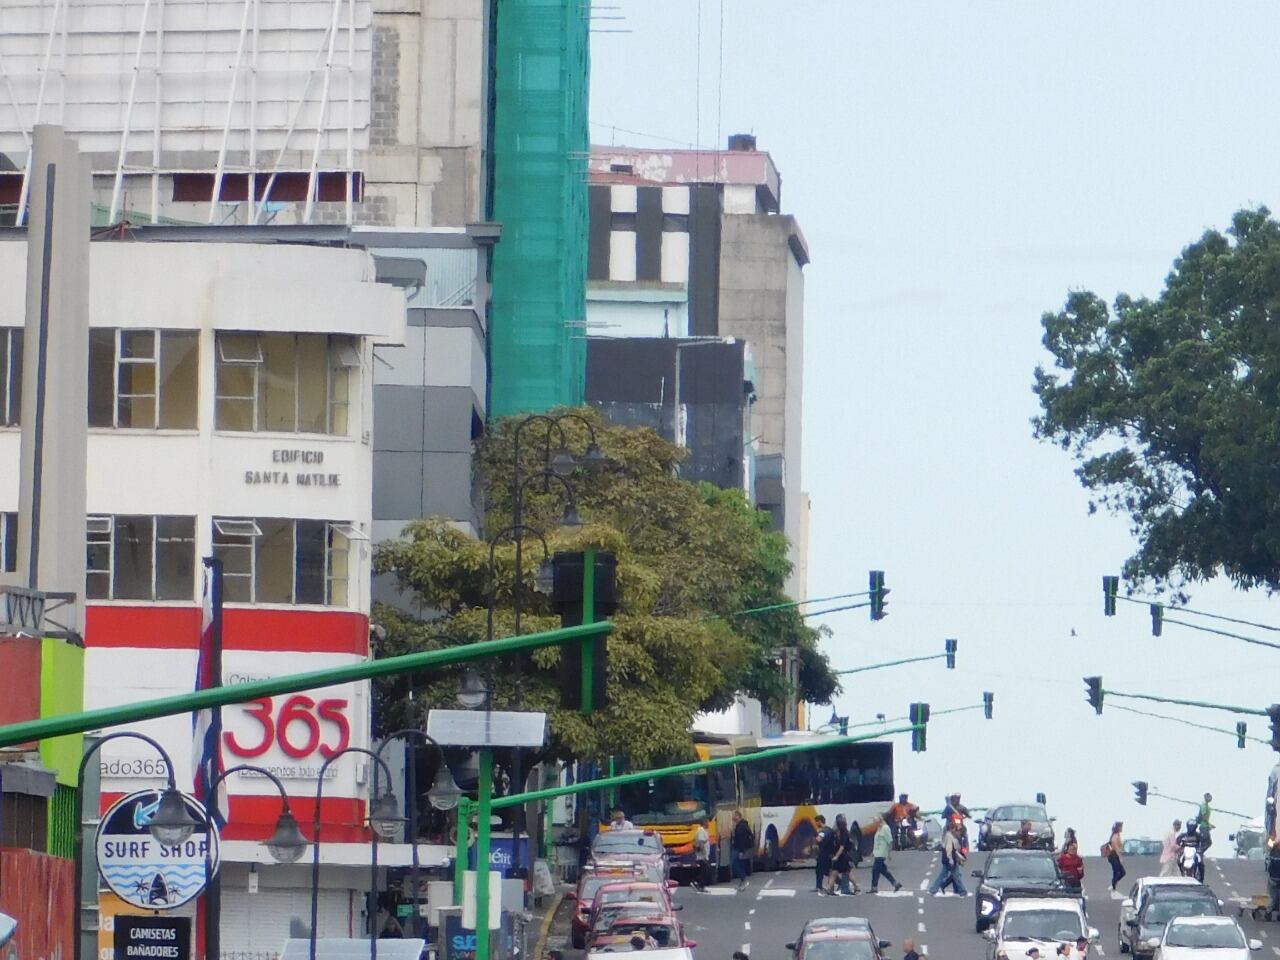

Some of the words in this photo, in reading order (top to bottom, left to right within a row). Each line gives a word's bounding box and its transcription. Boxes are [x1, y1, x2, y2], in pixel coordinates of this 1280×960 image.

[272, 449, 324, 464] EDIFICIO
[245, 471, 289, 484] SANTA
[223, 695, 349, 760] 365
[104, 842, 151, 858] SURF
[160, 841, 208, 858] SHOP
[130, 927, 177, 940] CAMISETAS
[127, 944, 179, 958] BAÑADORES
